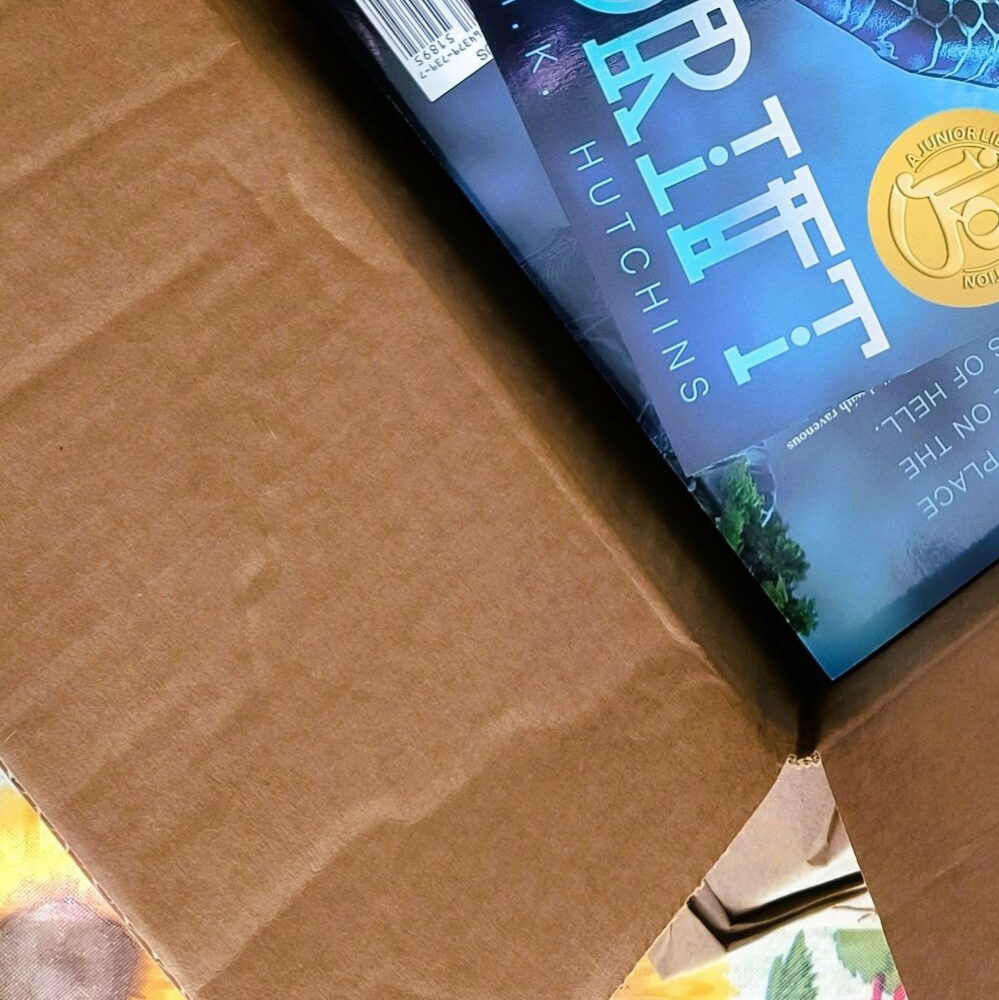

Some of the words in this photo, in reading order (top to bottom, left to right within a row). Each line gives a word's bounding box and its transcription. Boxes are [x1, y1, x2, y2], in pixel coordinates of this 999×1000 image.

[414, 33, 456, 67] 51895
[905, 154, 919, 168] A
[917, 126, 977, 158] JUNIOR
[568, 139, 709, 403] HUTCHINS
[953, 355, 984, 389] OF
[874, 382, 948, 433] HELL.
[952, 403, 992, 440] ON
[786, 408, 838, 450] ravenous
[898, 435, 953, 480] THE
[917, 450, 999, 520] PLACE
